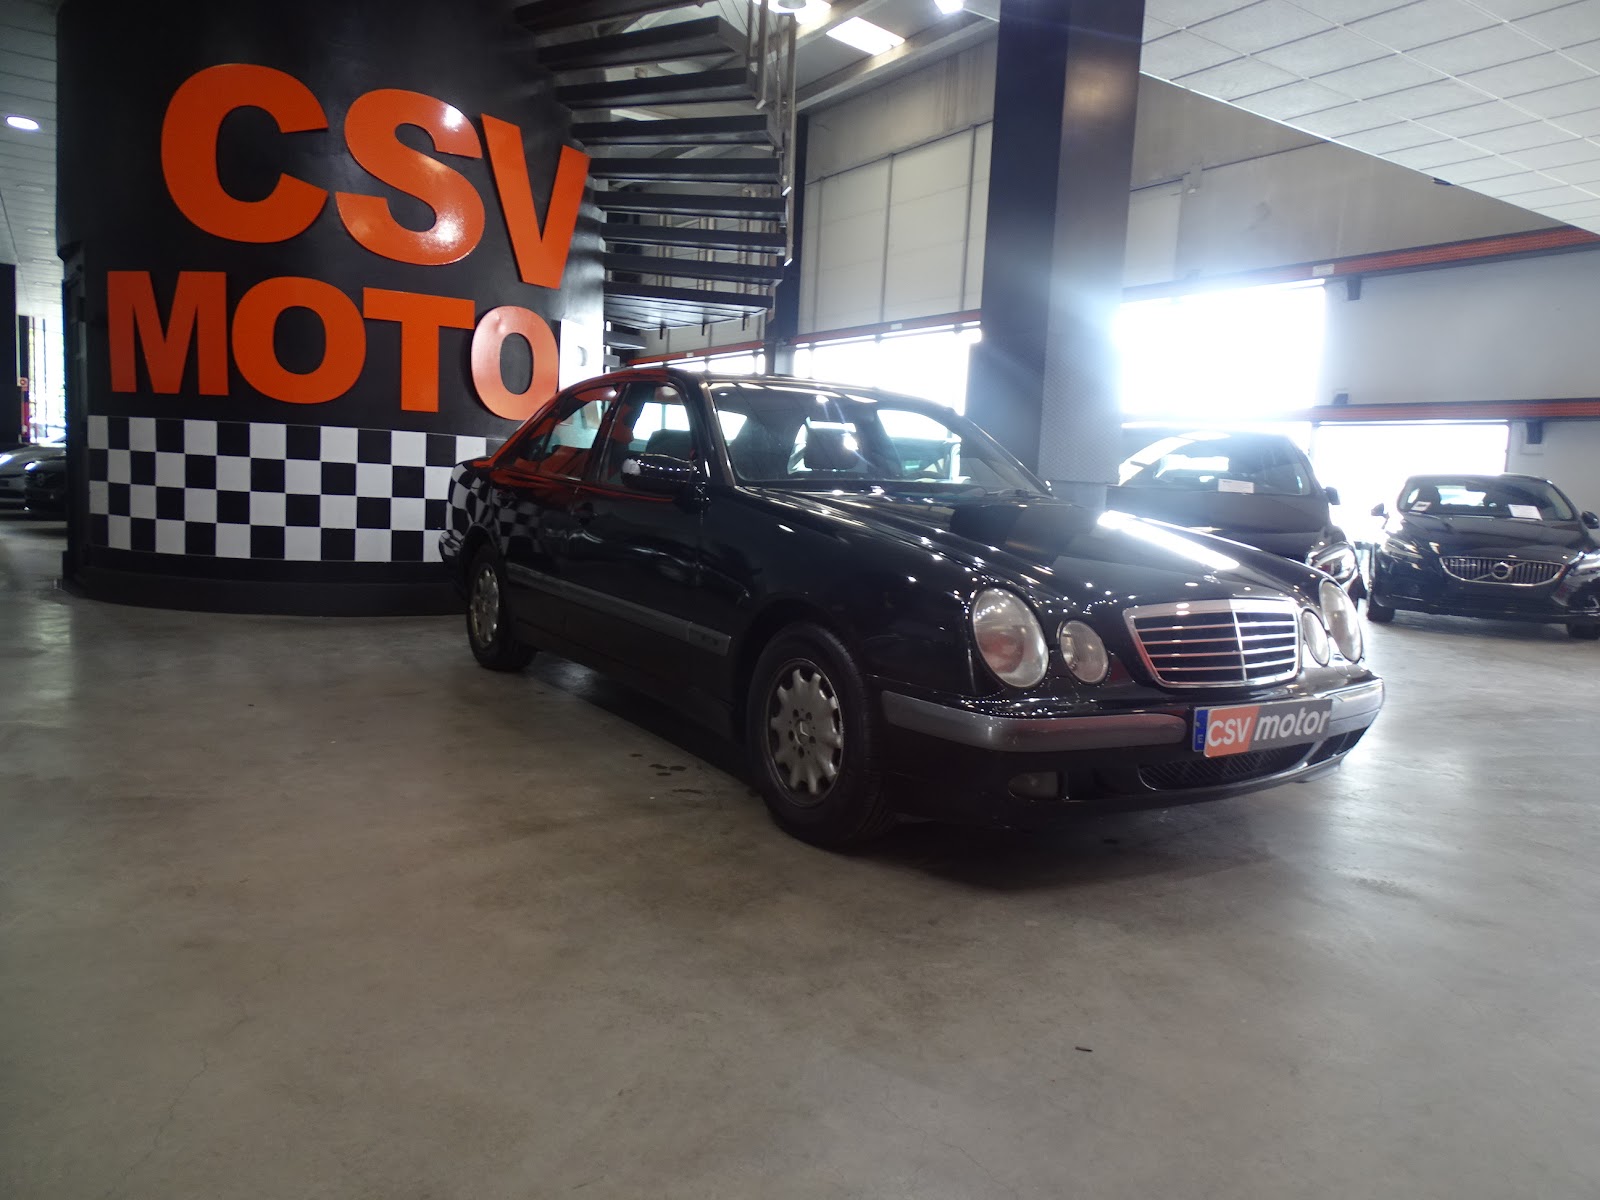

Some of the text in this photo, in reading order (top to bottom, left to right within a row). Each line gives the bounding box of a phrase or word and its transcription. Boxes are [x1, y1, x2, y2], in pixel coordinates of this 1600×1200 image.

[161, 63, 591, 290] CSV
[1207, 706, 1331, 747] CSV motor
